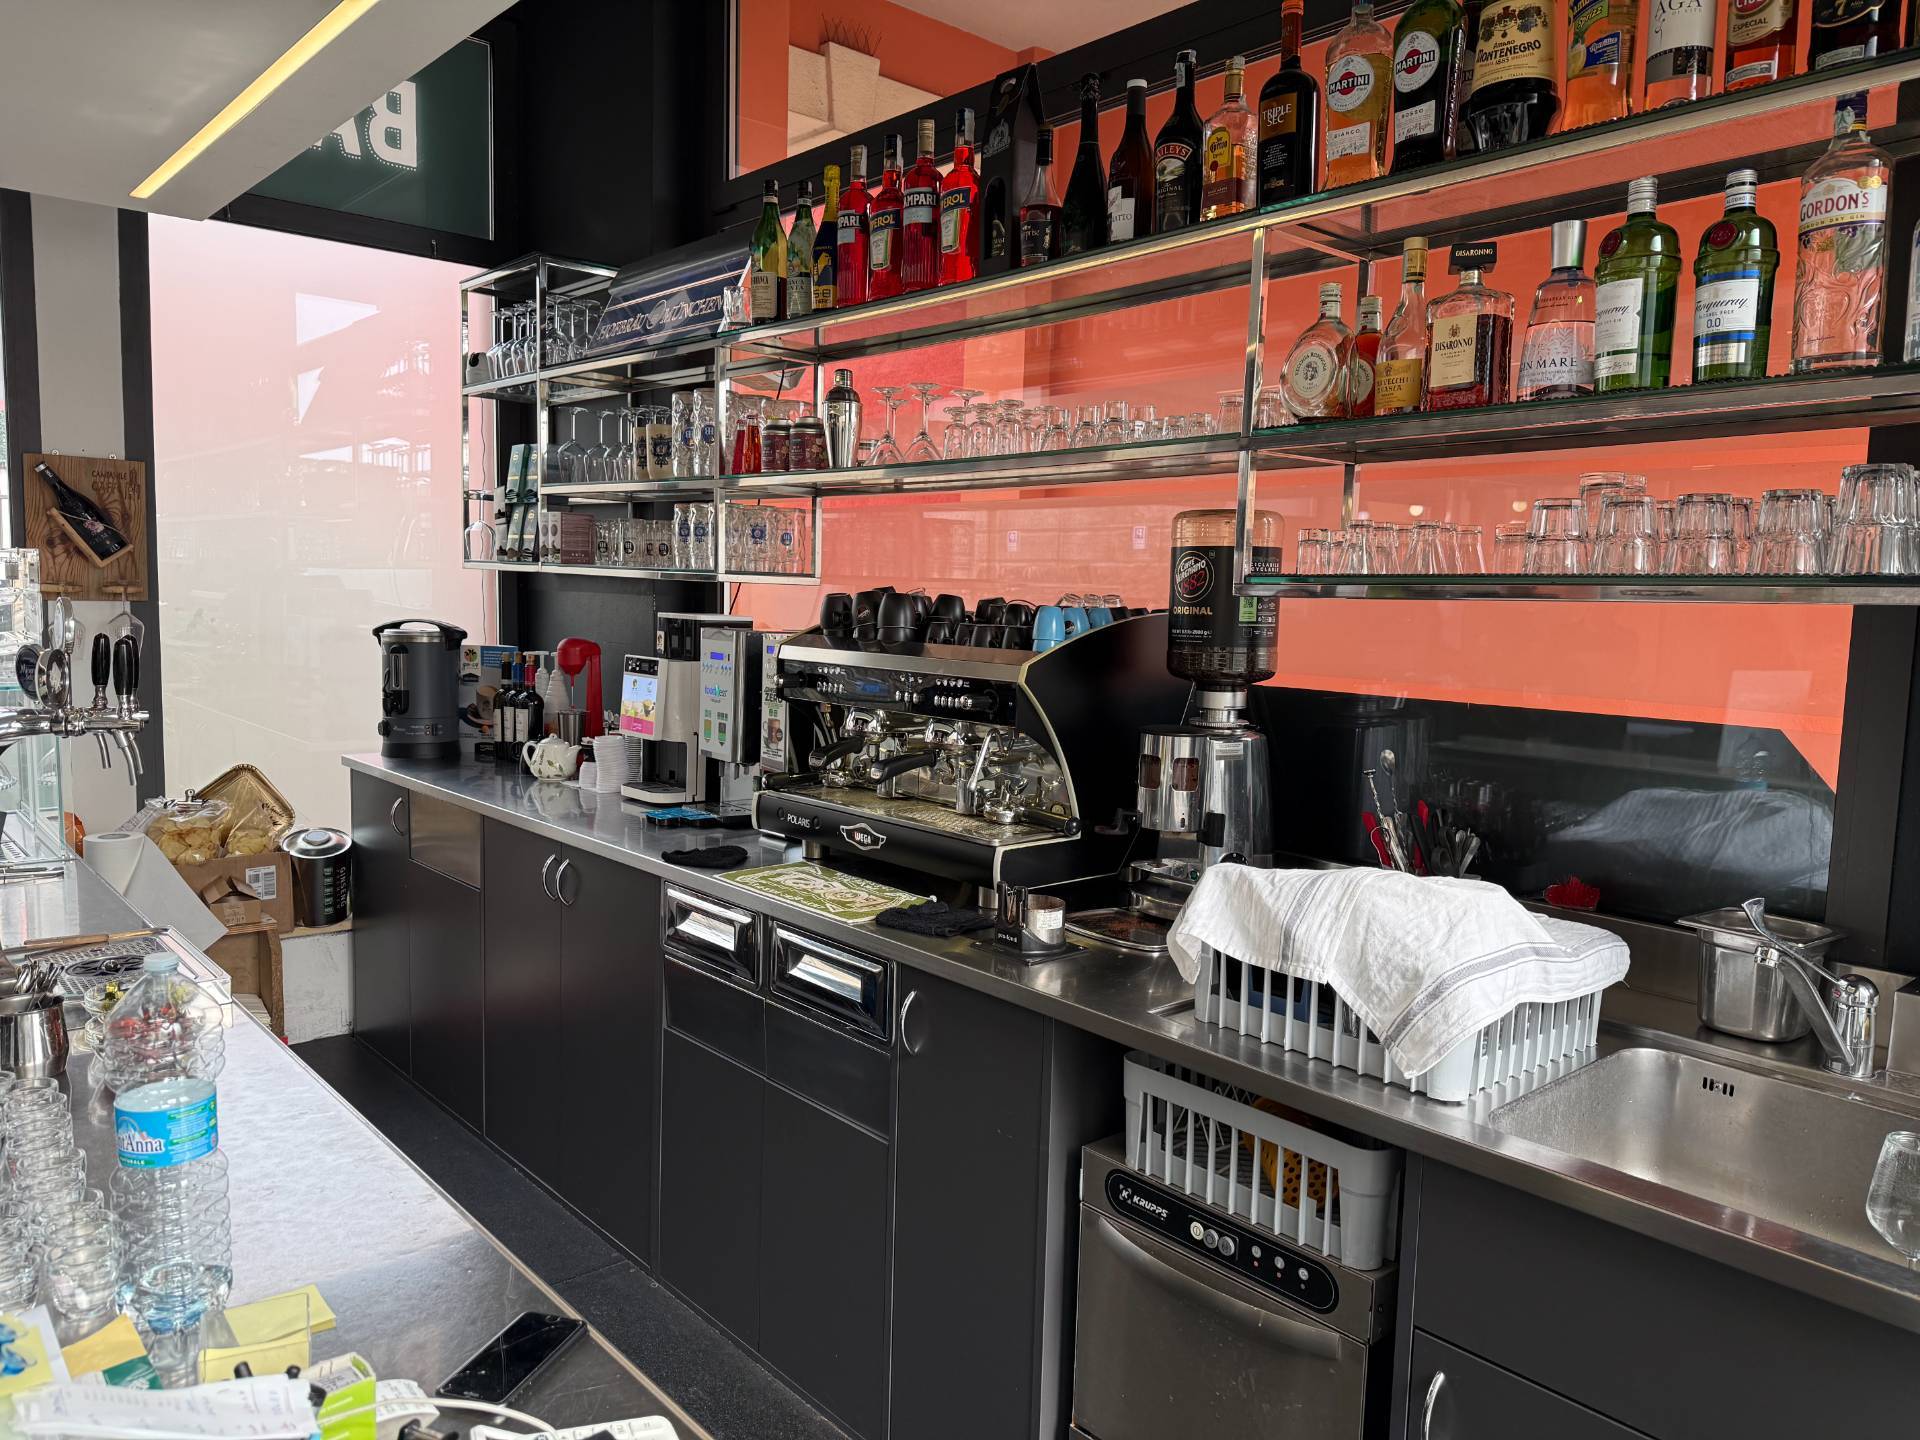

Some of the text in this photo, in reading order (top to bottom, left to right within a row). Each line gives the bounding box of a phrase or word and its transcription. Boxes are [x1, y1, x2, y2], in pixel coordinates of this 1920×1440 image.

[1733, 17, 1768, 32] ESPECIAL
[1477, 40, 1541, 63] MONTENEGRO
[1493, 40, 1515, 49] AMARO
[1395, 50, 1435, 74] MARTINI
[1328, 74, 1370, 95] MARTINI
[1262, 103, 1292, 120] TRIPLE
[1267, 114, 1285, 127] SEC
[1156, 143, 1187, 158] AILEYS
[904, 193, 937, 207] AMPARI
[1800, 191, 1870, 221] GORDON'S
[839, 215, 860, 228] PARI
[1455, 248, 1494, 257] DISARONNO
[1706, 317, 1721, 329] 0.0
[1435, 336, 1473, 352] DISARONNO
[1536, 357, 1577, 369] MARE
[1173, 606, 1213, 616] ORIGINAL
[787, 813, 811, 829] POLARIS
[854, 832, 871, 845] WEGA
[1132, 1195, 1168, 1218] KRUPPS
